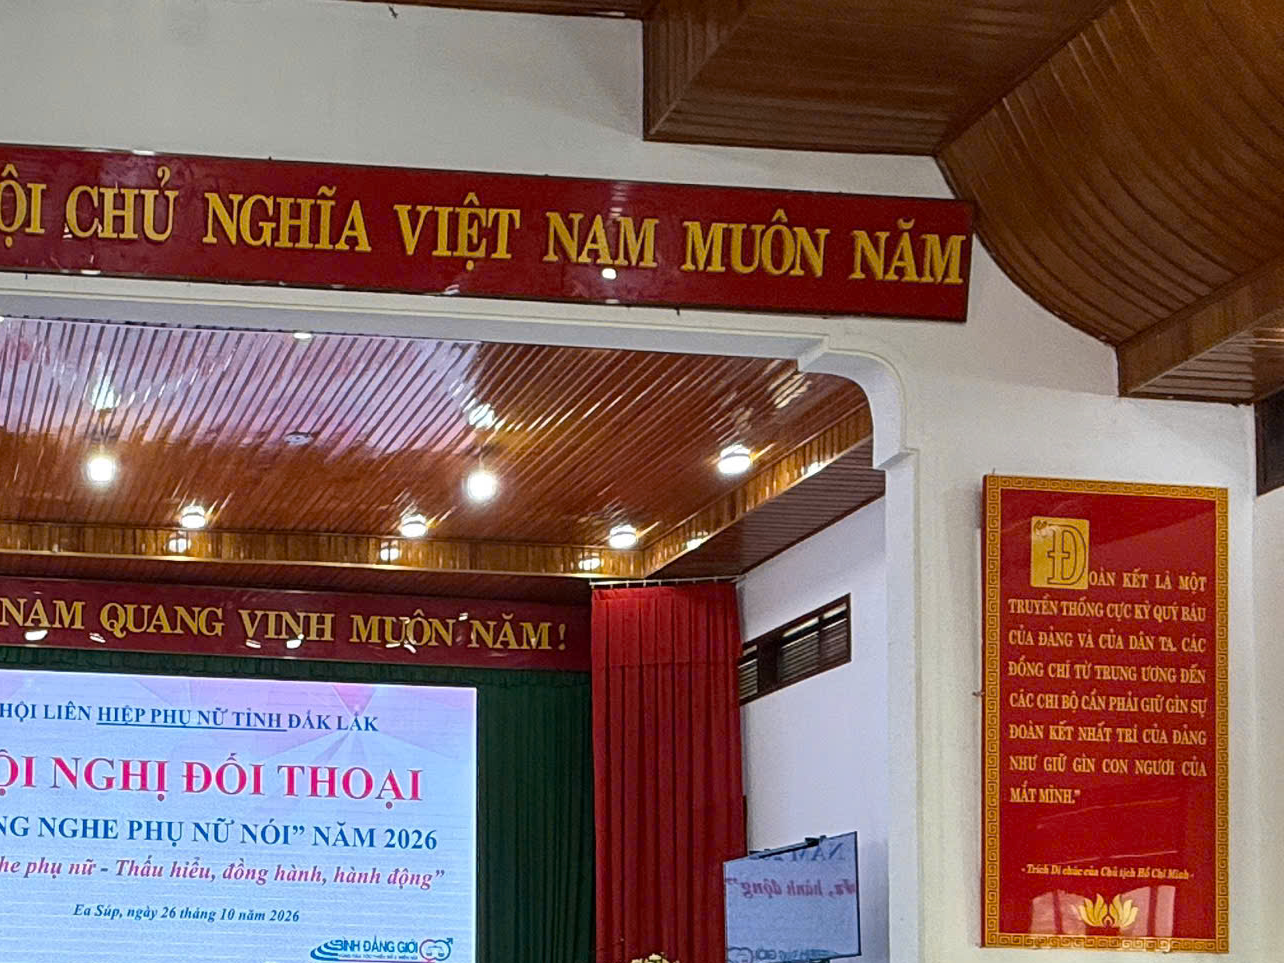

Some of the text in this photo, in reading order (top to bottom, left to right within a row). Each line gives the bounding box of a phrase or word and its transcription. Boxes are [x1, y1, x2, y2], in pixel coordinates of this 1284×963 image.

[66, 166, 179, 242] CHỦ
[202, 185, 371, 253] NGHĨA
[393, 190, 520, 273] VIỆT
[542, 211, 658, 268] NAM
[680, 207, 830, 278] MUÔN
[849, 220, 964, 285] NĂM
[1122, 568, 1207, 594] KẾT MỘT
[0, 597, 85, 630] NAM
[99, 602, 224, 638] QUANG
[238, 609, 335, 642] VINH
[349, 609, 456, 647] MUÔN
[0, 701, 37, 722] HỘI
[43, 700, 92, 721] LIÊN
[197, 707, 229, 725] NỮ
[51, 756, 169, 802] NGHỊ
[182, 753, 265, 796] ĐỐI
[277, 765, 423, 809] THOẠI
[37, 816, 118, 839] NGHE
[127, 820, 184, 847] PHỤ
[191, 817, 235, 844] NỮ
[240, 818, 305, 845] NÓI”
[312, 821, 376, 848] NĂM
[384, 828, 437, 850] 2026
[24, 857, 63, 879] phụ
[68, 859, 97, 876] nữ
[116, 855, 164, 878] Thấu
[170, 857, 216, 881] hiểu,
[222, 858, 268, 886] đồng
[274, 864, 327, 885] hành,
[333, 866, 381, 885] hành
[387, 868, 445, 890] động”
[73, 904, 299, 922] Ea Súp, ngày 26 tháng 10 năm 2026
